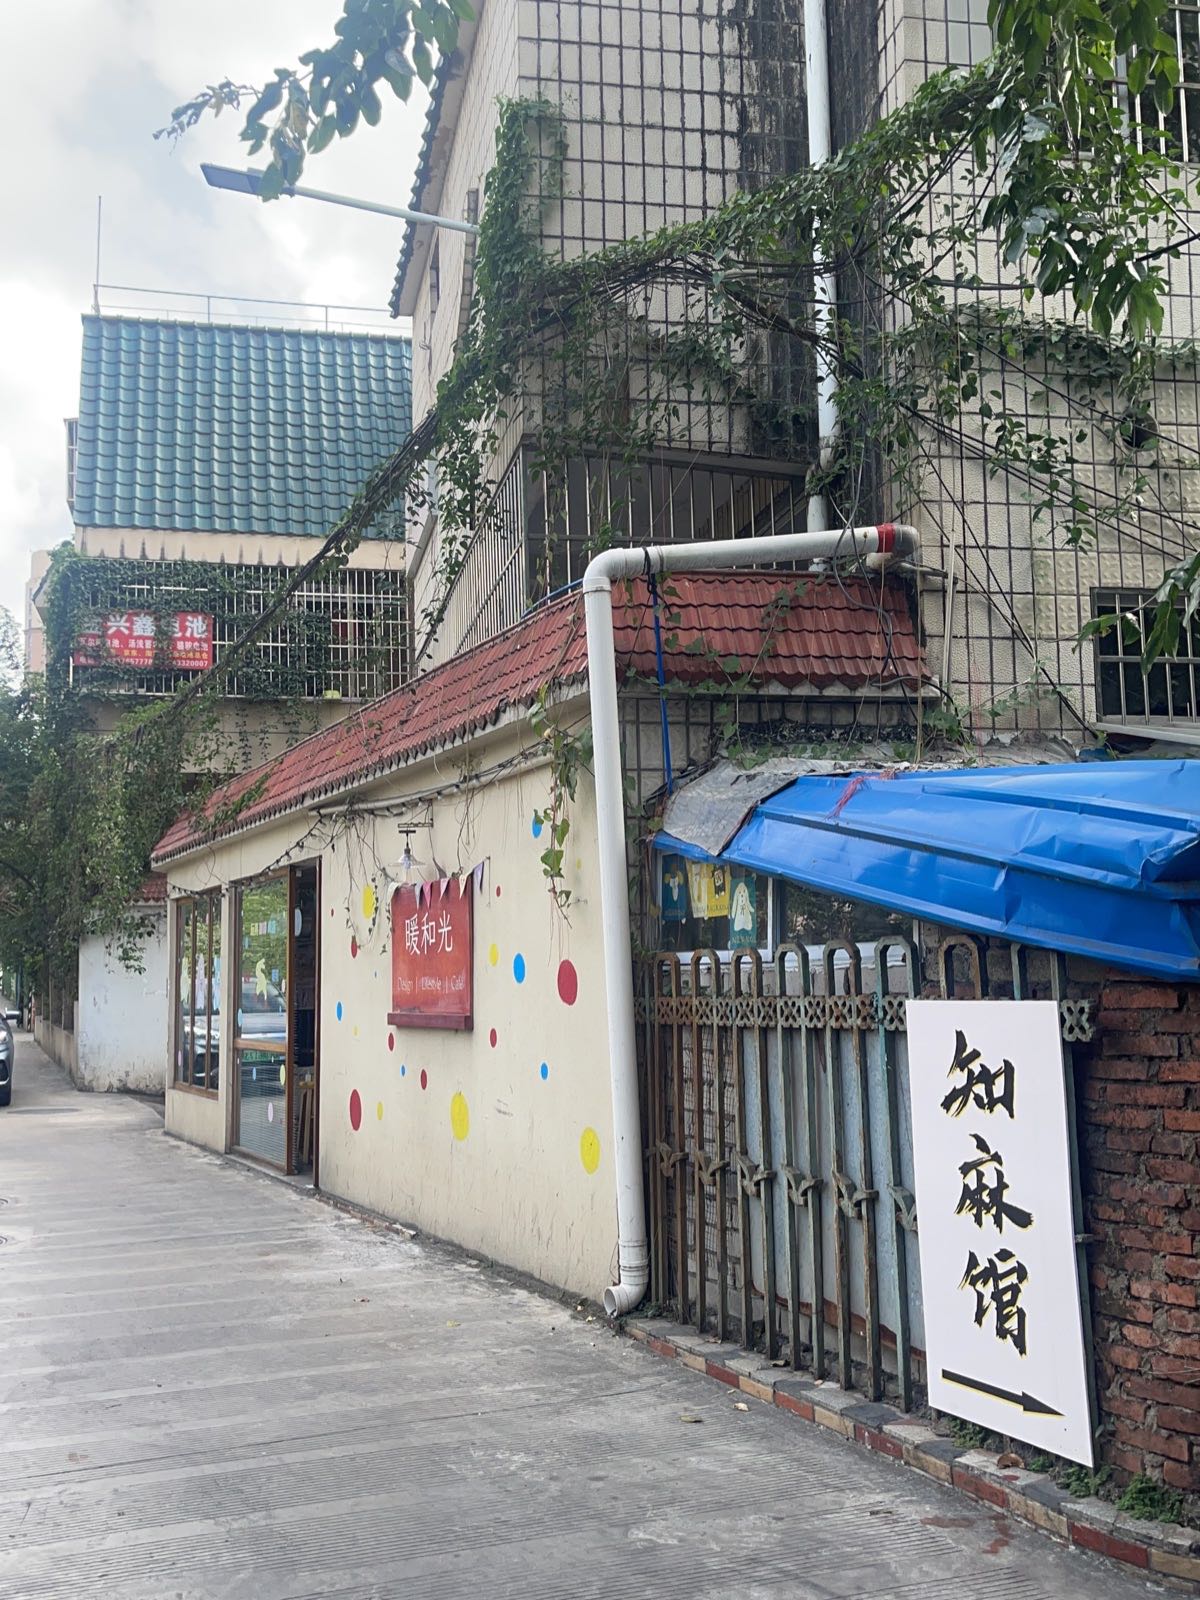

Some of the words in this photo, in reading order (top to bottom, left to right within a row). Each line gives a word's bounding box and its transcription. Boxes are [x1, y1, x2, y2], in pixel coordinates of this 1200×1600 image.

[405, 910, 454, 955] 暖和光
[940, 1028, 1034, 1357] 知麻馆
